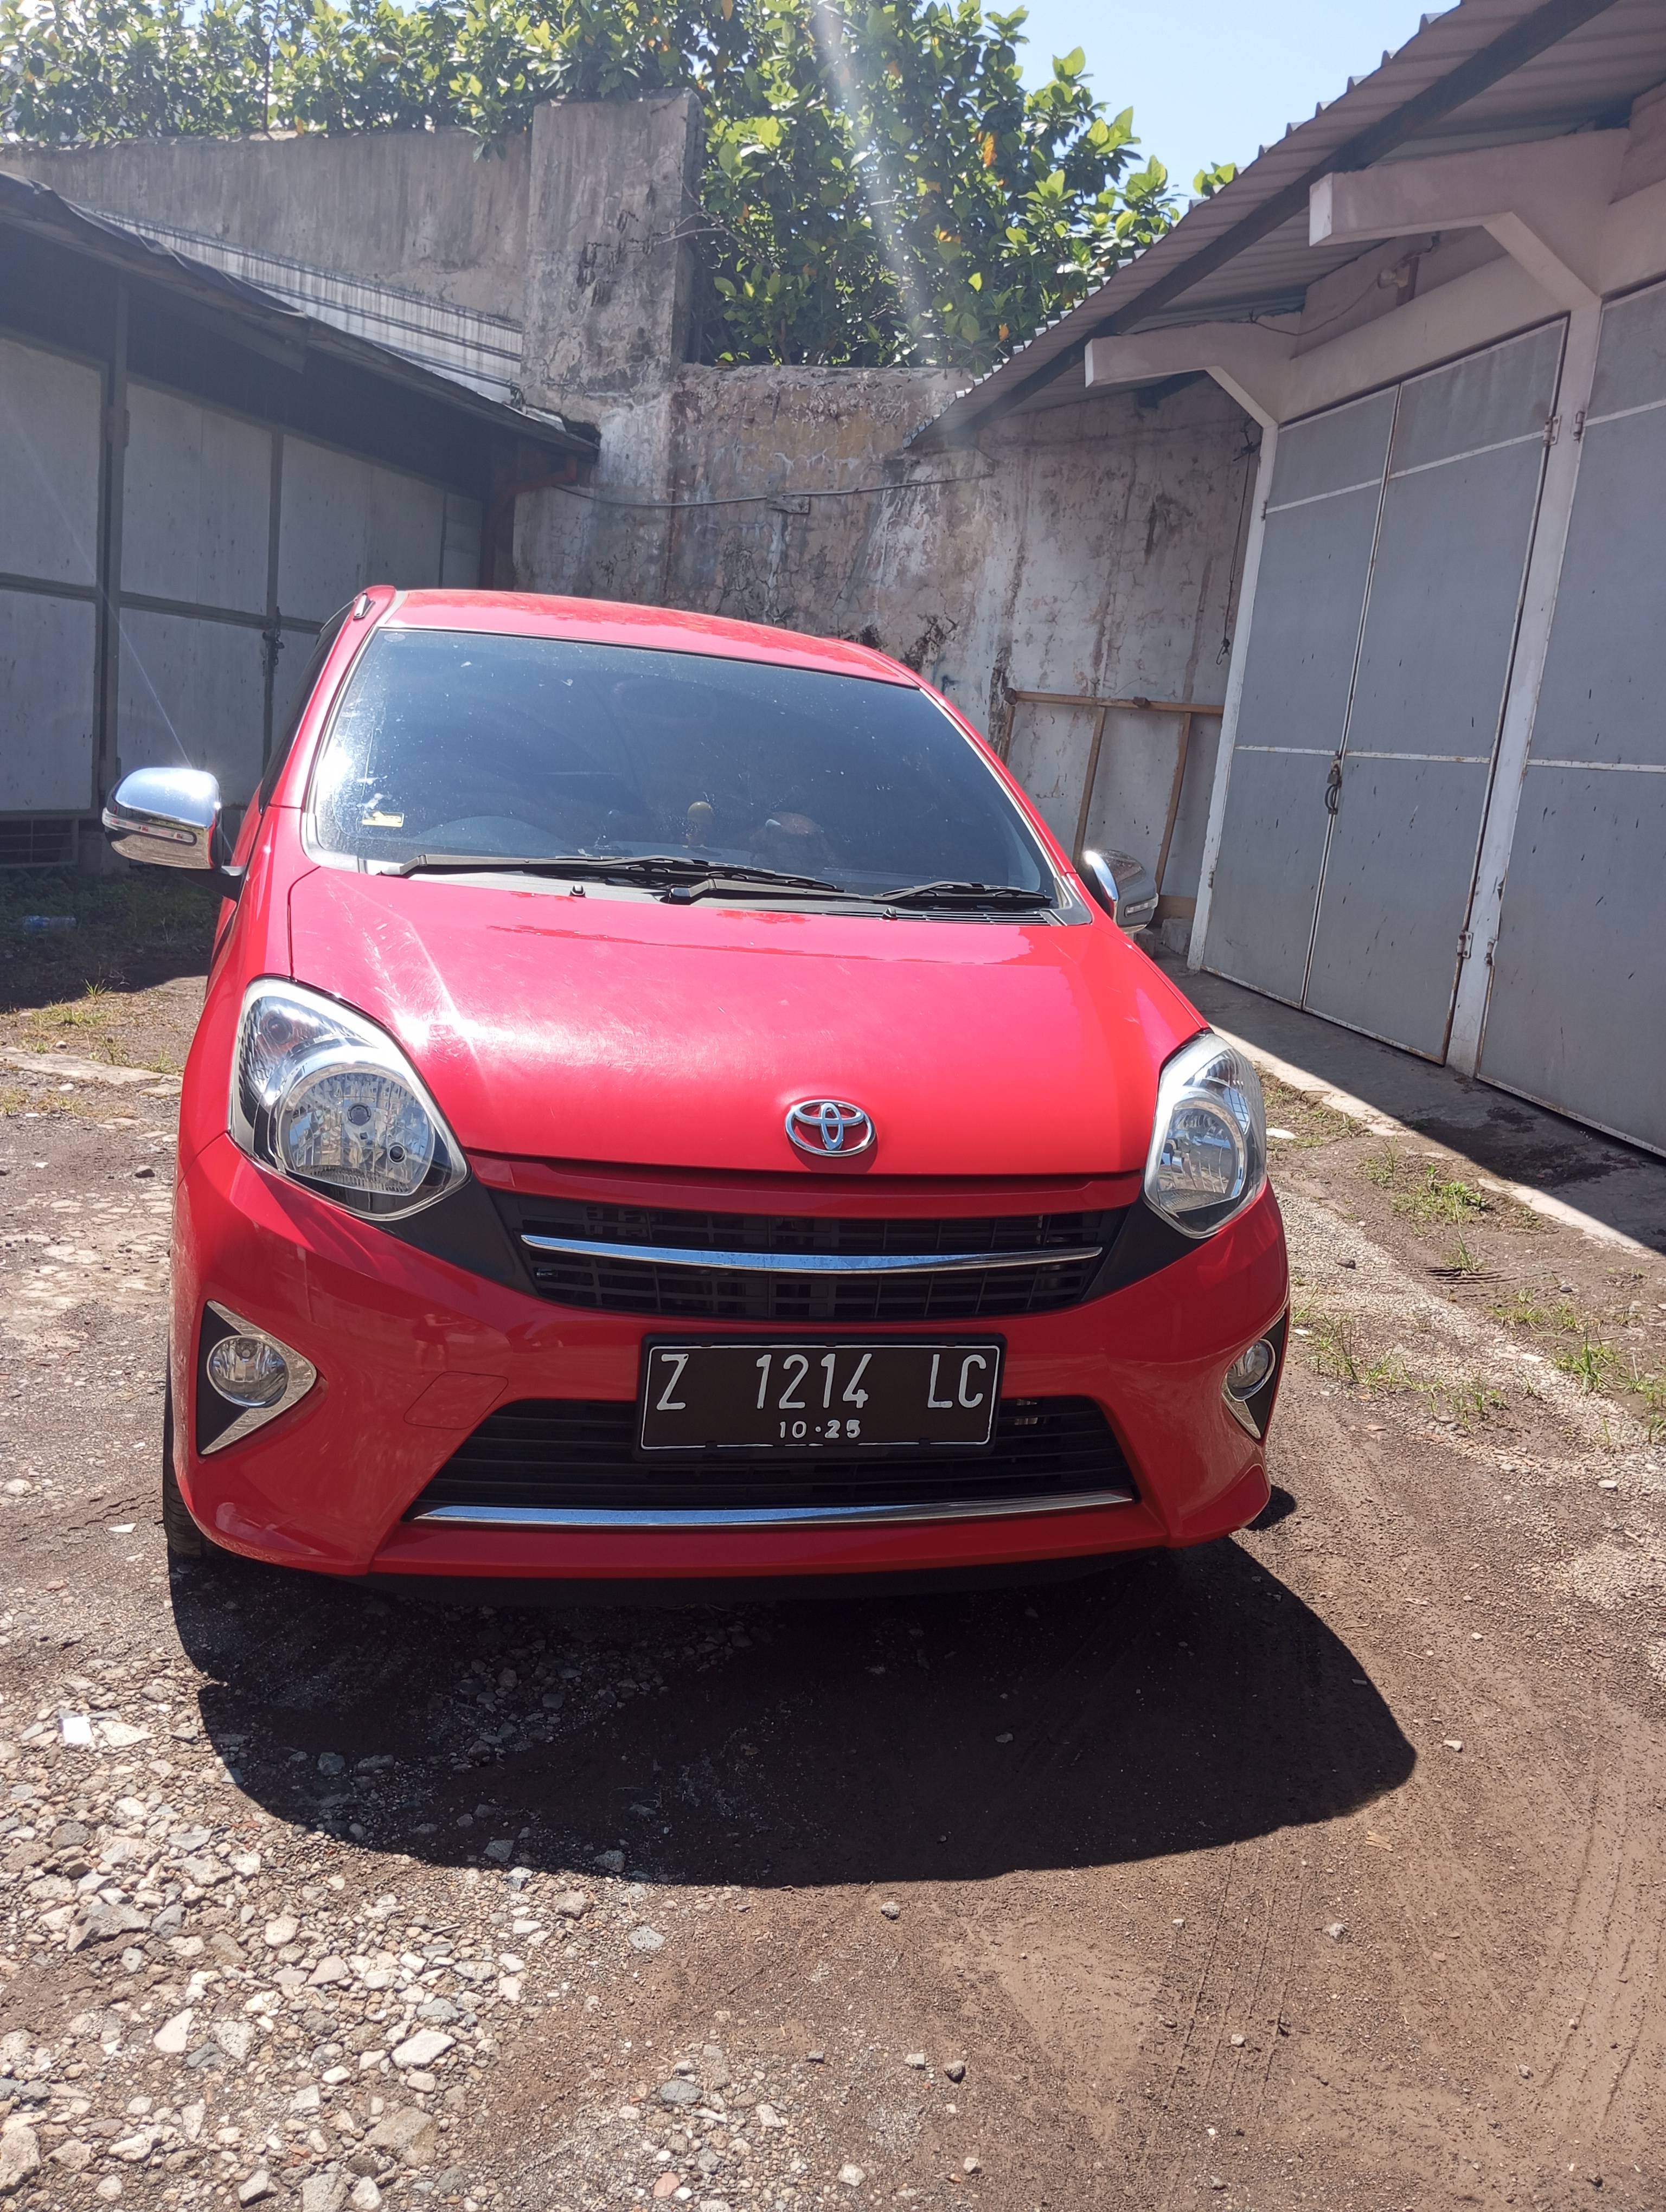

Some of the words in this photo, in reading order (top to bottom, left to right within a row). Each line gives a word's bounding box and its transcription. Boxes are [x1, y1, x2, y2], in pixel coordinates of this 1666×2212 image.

[657, 1354, 689, 1410] Z
[757, 1354, 872, 1409] 1214
[928, 1354, 986, 1408] LC
